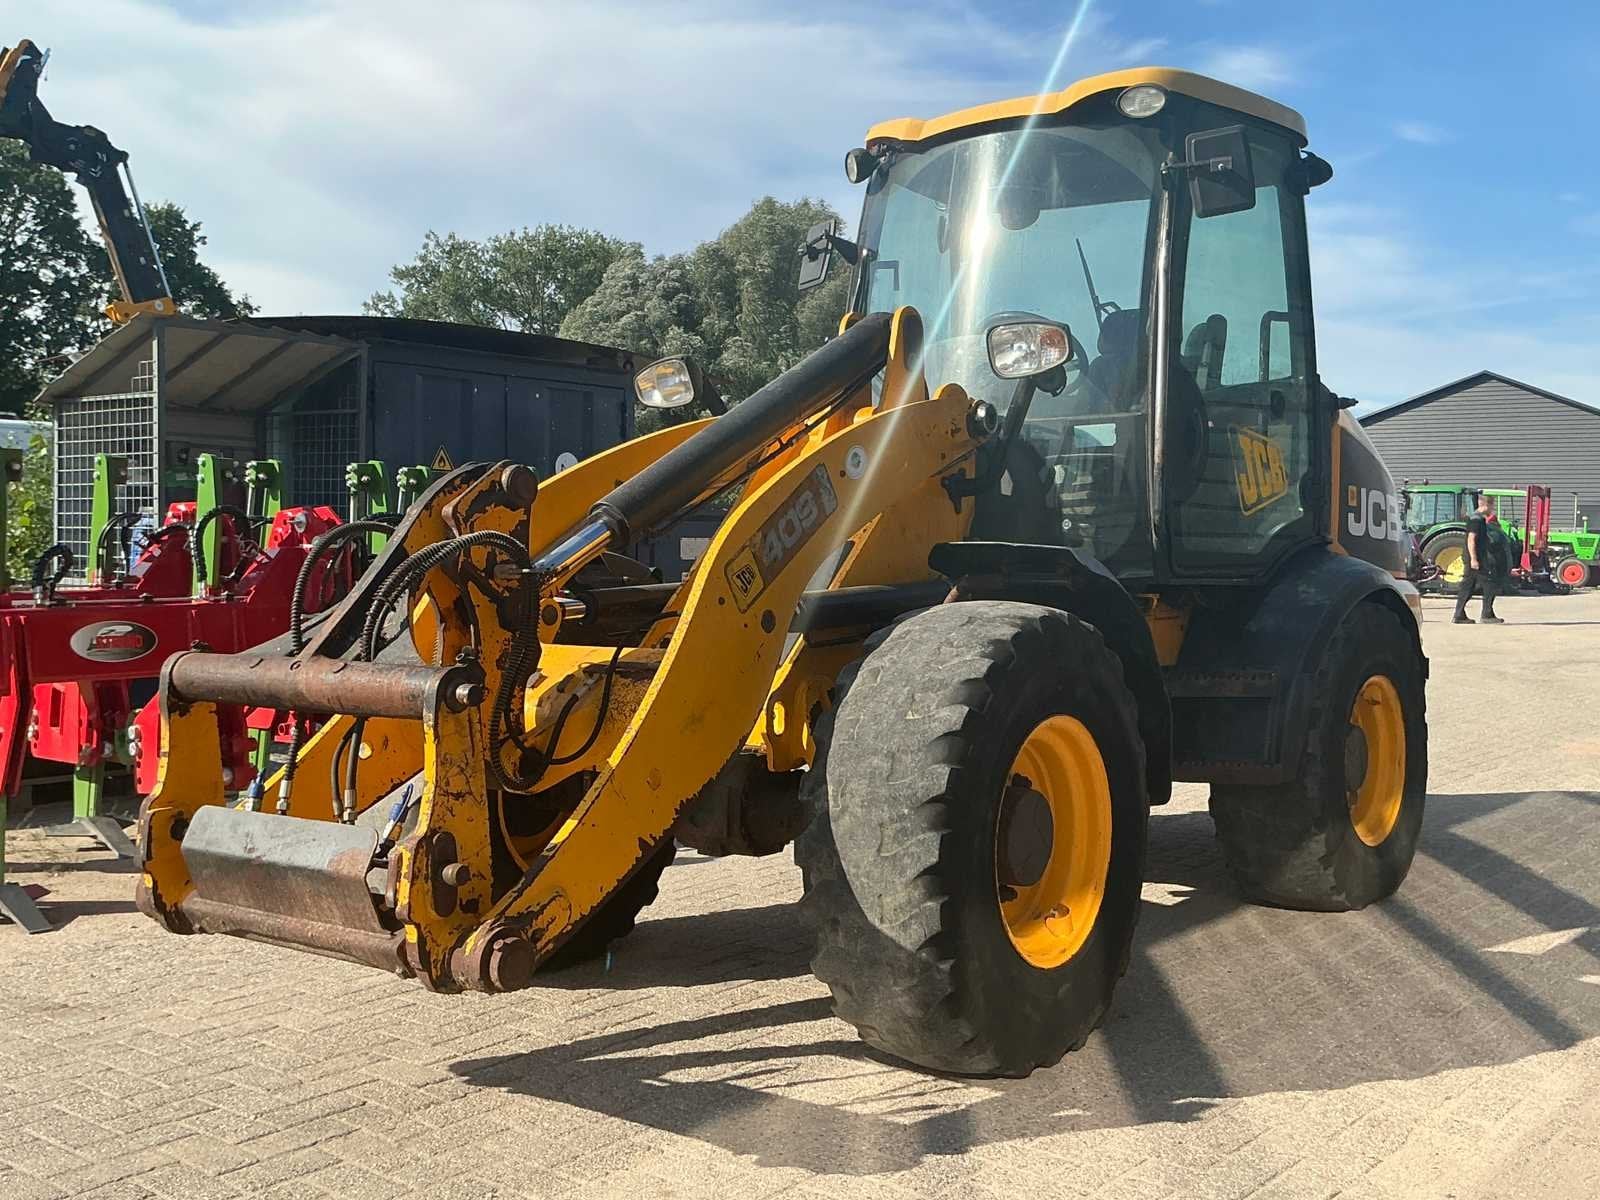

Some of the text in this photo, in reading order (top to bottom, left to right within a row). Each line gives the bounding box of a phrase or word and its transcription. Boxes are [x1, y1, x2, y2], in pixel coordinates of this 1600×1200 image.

[1239, 436, 1288, 505] JCB
[760, 489, 819, 565] 409
[1347, 487, 1400, 541] JCB
[735, 565, 756, 594] JCB
